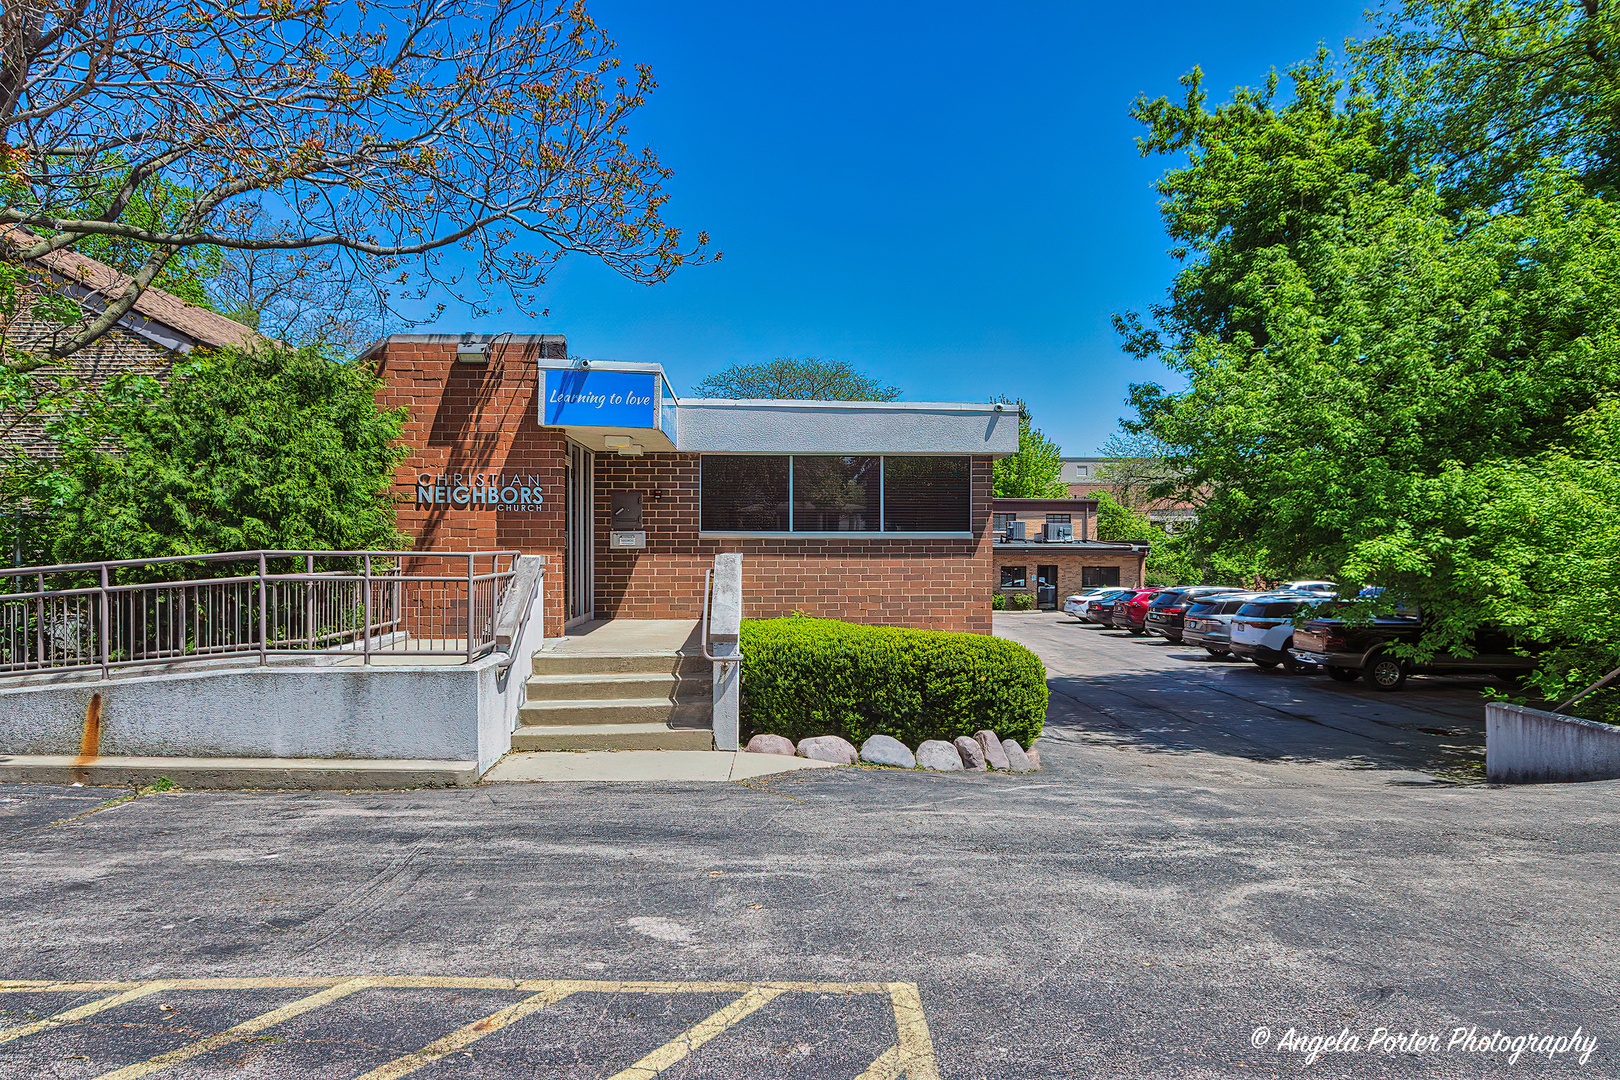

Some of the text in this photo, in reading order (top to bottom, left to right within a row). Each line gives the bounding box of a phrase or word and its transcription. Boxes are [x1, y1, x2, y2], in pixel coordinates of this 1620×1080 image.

[549, 389, 651, 409] Learning to love
[417, 472, 541, 488] CHRISTIAN
[417, 486, 544, 504] NEIGHBORS
[497, 503, 543, 512] CHURCH
